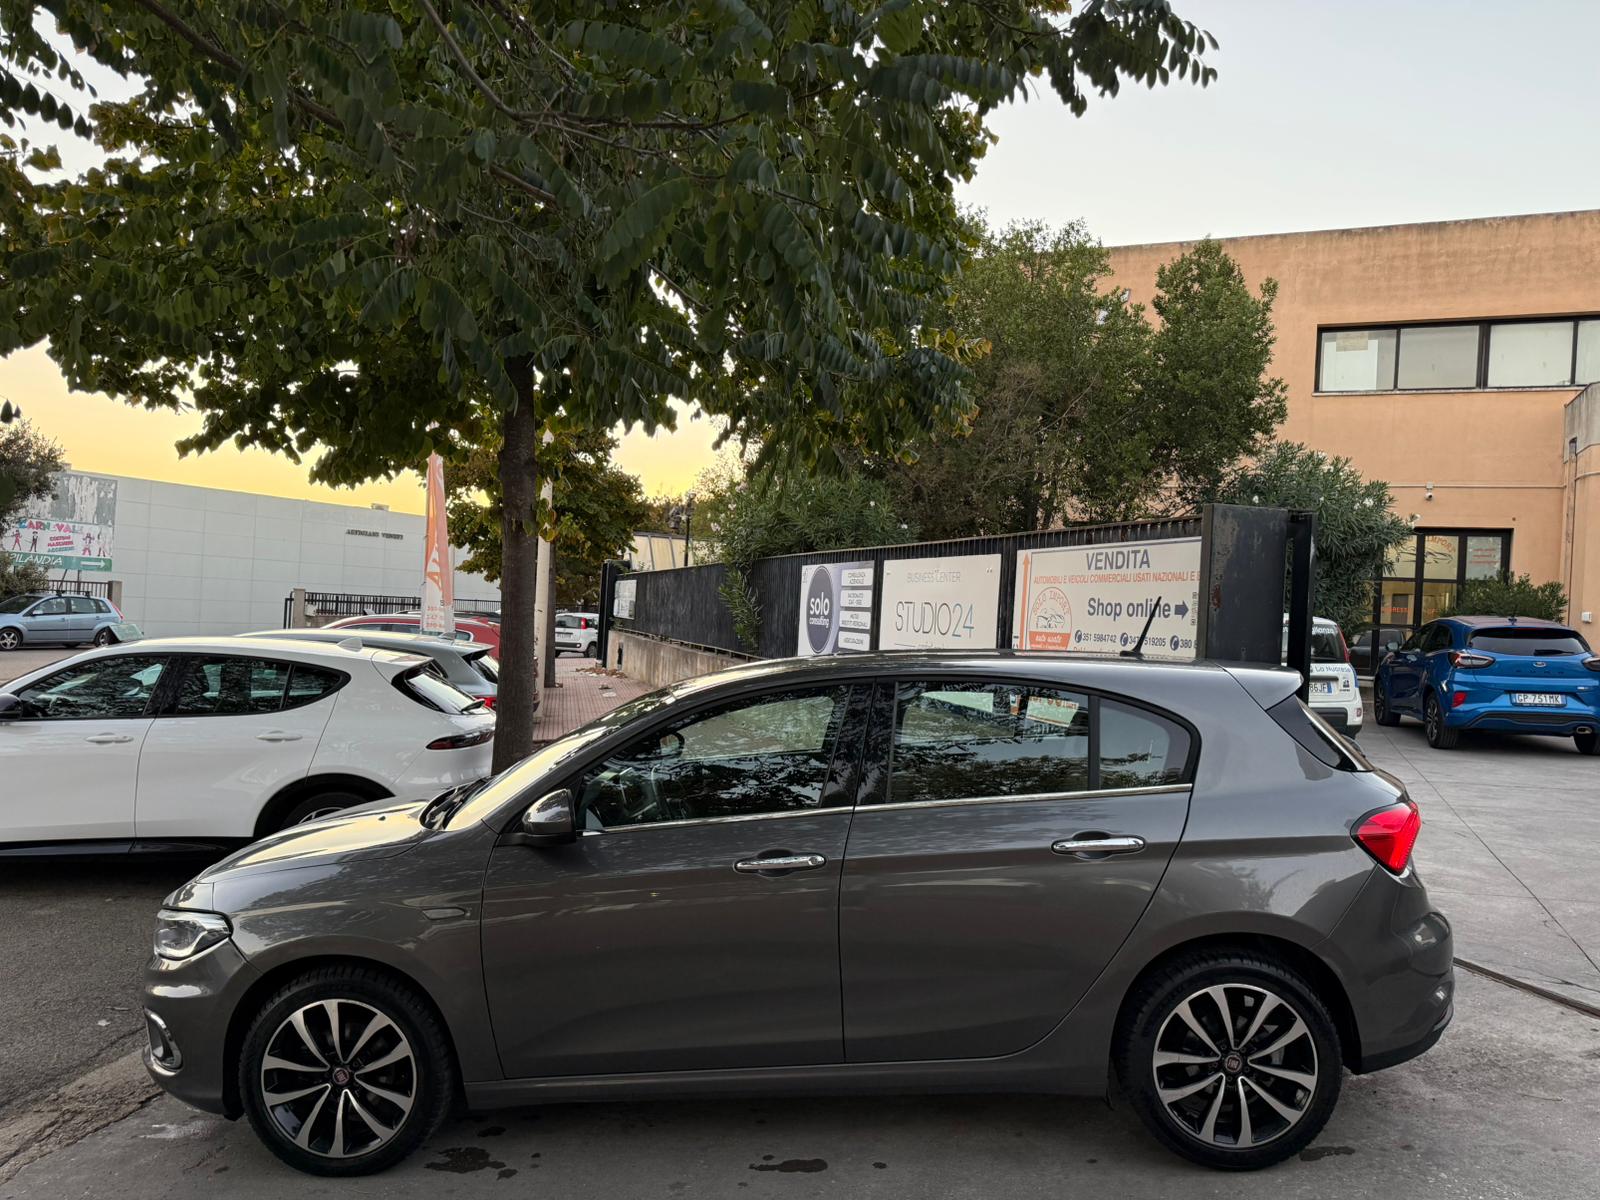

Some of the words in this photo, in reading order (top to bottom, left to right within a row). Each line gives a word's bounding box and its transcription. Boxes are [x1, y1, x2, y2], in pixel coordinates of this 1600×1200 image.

[1086, 549, 1150, 570] VENDITA
[1033, 575, 1062, 585] AUTOMOBILI
[1068, 574, 1088, 584] VEICOLI
[1089, 572, 1131, 584] COMMERCIALI
[1132, 572, 1151, 583] USATI
[1152, 570, 1188, 582] NAZIONALI
[810, 592, 830, 616] solo
[1087, 597, 1122, 622] Shop
[808, 616, 830, 629] consulting
[896, 601, 975, 639] STUDIO24
[1082, 632, 1092, 641] 351
[1179, 639, 1192, 649] 380
